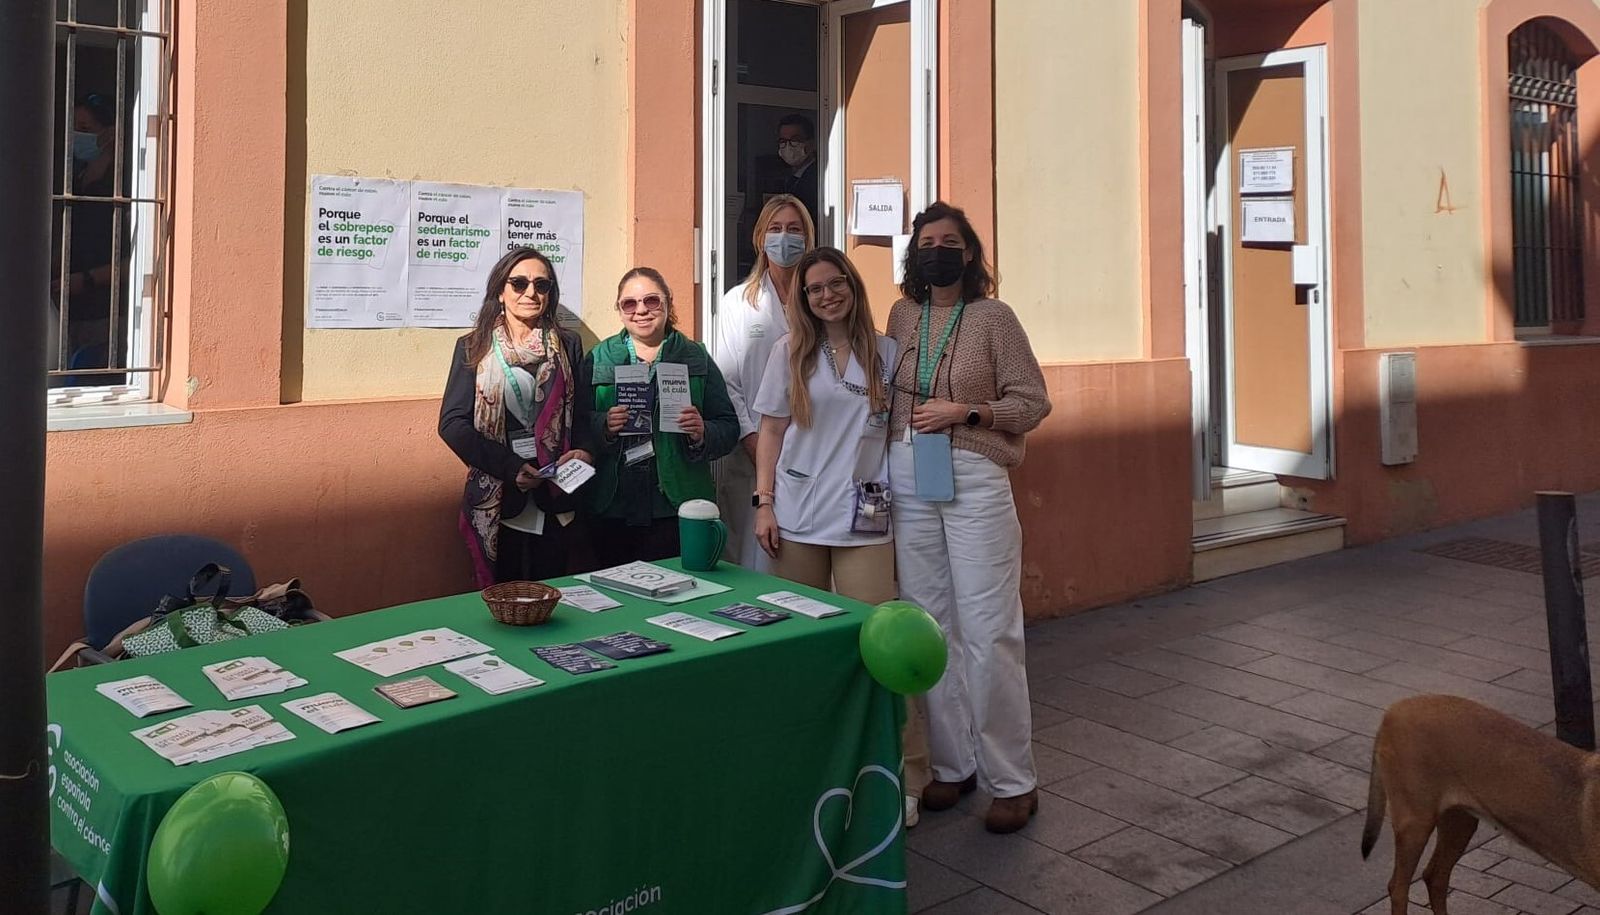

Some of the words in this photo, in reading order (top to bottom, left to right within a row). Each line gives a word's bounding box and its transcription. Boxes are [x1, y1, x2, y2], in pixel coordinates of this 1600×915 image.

[318, 207, 361, 221] Porque
[418, 211, 456, 226] Porque
[459, 214, 469, 224] el
[318, 220, 330, 231] el
[333, 221, 394, 235] sobrepeso
[507, 217, 543, 230] Porque
[417, 225, 491, 237] sedentarismo
[507, 230, 534, 240] tener
[536, 230, 557, 240] más
[318, 235, 332, 244] es
[335, 235, 350, 244] un
[353, 234, 388, 246] factor
[417, 238, 429, 247] es
[432, 238, 446, 247] un
[448, 237, 480, 249] factor
[507, 241, 520, 250] de
[537, 241, 560, 252] años
[317, 246, 333, 256] de
[336, 246, 375, 260] riesgo.
[416, 248, 430, 258] de
[433, 249, 469, 262] riesgo.
[64, 750, 99, 792] asociación
[61, 773, 91, 812] española
[57, 796, 78, 827] contra
[77, 817, 85, 834] el
[84, 826, 112, 855] cánce
[575, 884, 661, 915] ciación
